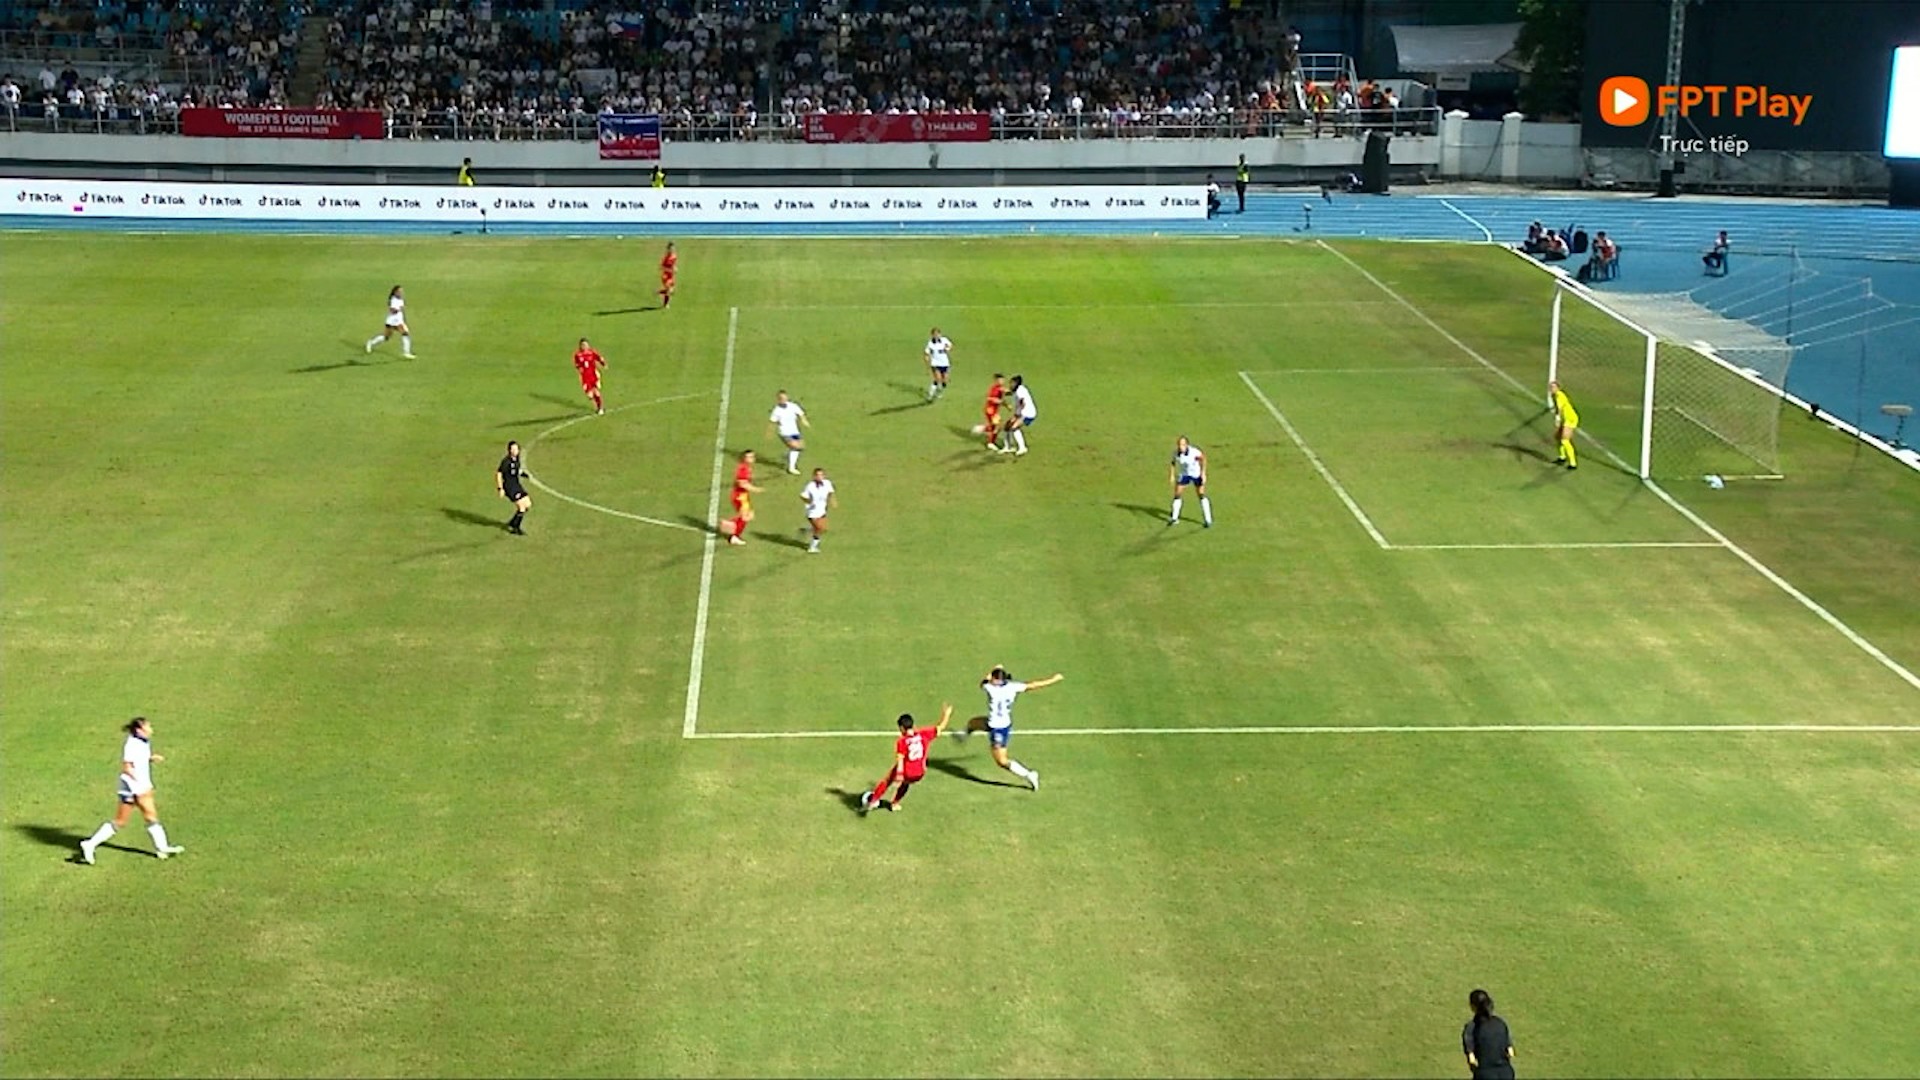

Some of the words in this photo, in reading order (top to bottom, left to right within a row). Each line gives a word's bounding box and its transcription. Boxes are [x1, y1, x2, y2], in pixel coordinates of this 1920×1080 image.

[224, 112, 280, 124] WOMEN'S
[282, 113, 340, 126] FOOTBALL
[927, 121, 978, 131] THAILAND
[29, 193, 63, 203] TikTok
[91, 193, 125, 204] TikTok
[152, 193, 184, 204] TikTok
[210, 194, 241, 205] TikTok
[270, 195, 301, 206] TikTok
[329, 196, 360, 207] TikTok
[390, 197, 420, 208] TikTok
[447, 197, 478, 208] TikTok
[504, 197, 534, 208] TikTok
[558, 198, 588, 208] TikTok
[615, 198, 644, 209] TikTok
[671, 198, 701, 209] TikTok
[730, 199, 759, 209] TikTok
[785, 198, 814, 209] TikTok
[840, 198, 869, 208] TikTok
[893, 198, 921, 208] TikTok
[948, 198, 977, 208] TikTok
[1004, 197, 1032, 208] TikTok
[1061, 197, 1089, 207] TikTok
[1116, 197, 1145, 207] TikTok
[1171, 196, 1200, 206] TikTok
